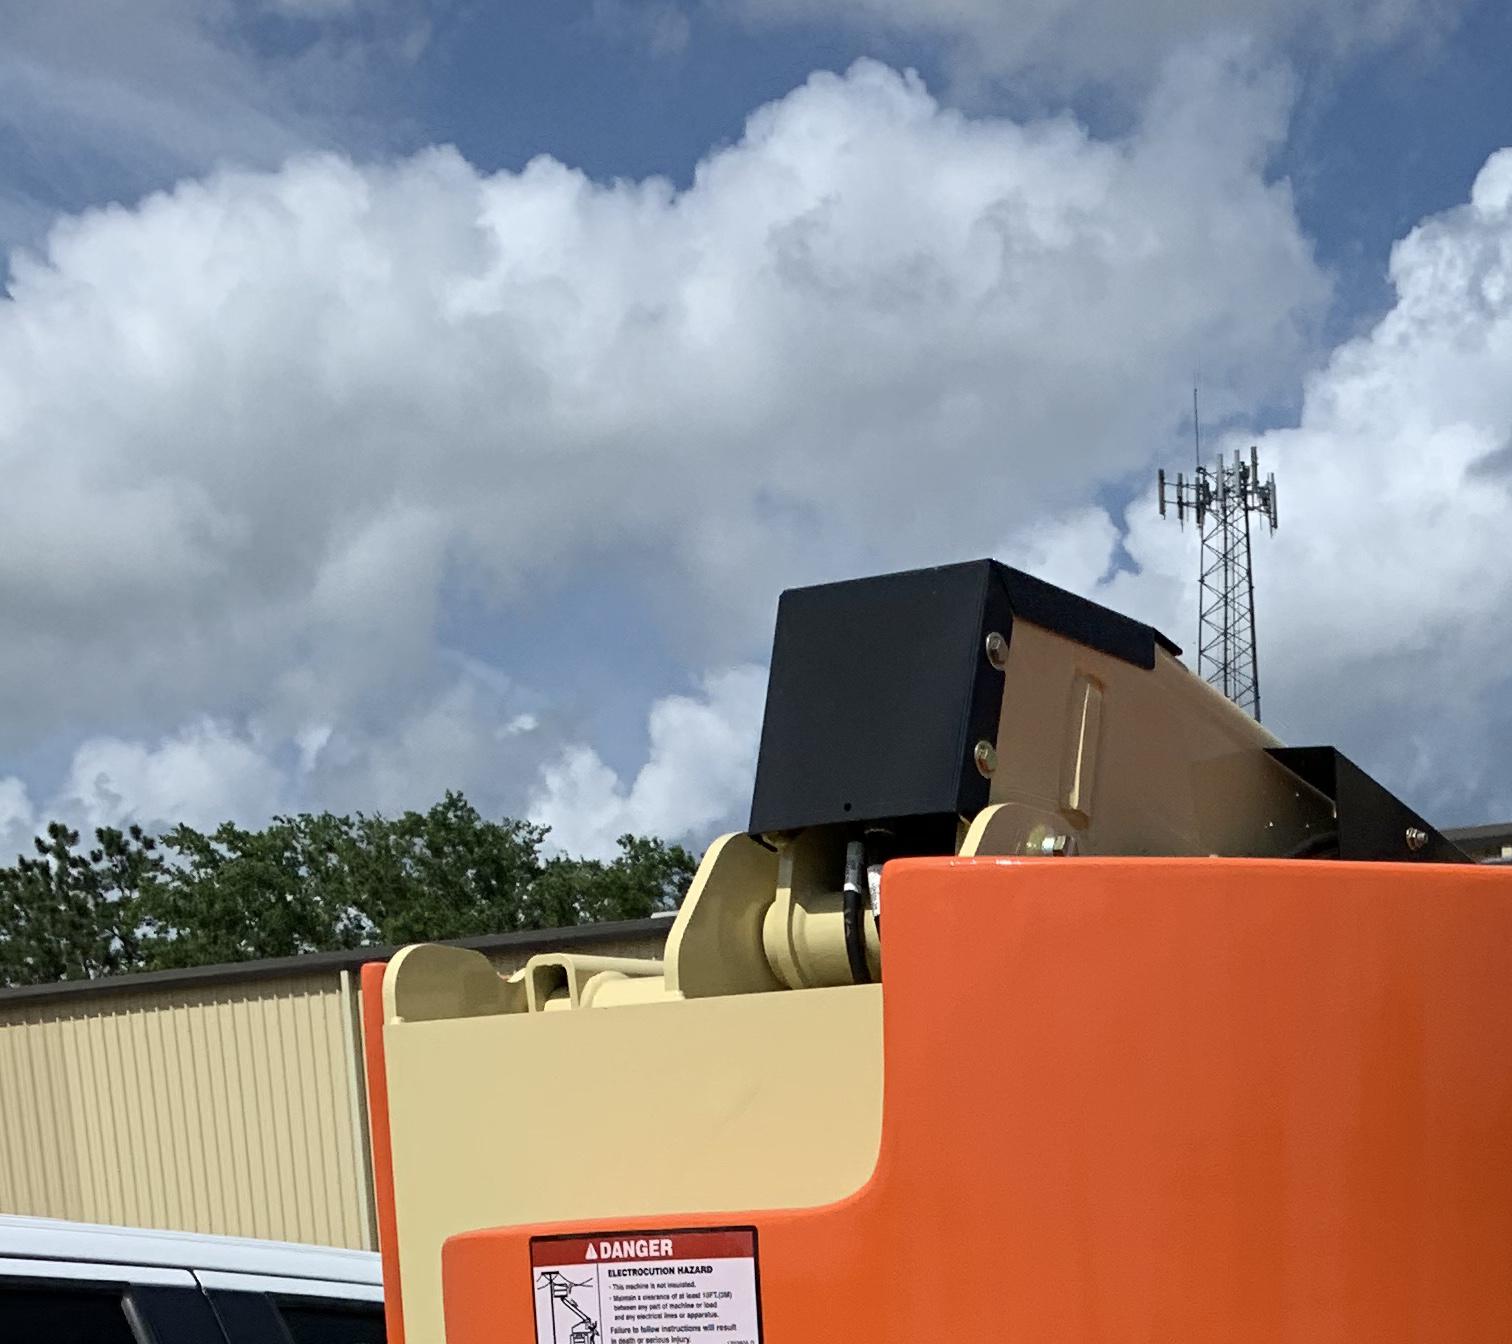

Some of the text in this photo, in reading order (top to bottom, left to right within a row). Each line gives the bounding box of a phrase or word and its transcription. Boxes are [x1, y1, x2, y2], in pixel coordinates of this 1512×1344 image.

[600, 1239, 673, 1259] DANGER
[608, 1266, 713, 1277] ELECTROCUTION HAZARD
[641, 1325, 659, 1333] follow
[661, 1324, 701, 1332] instructions
